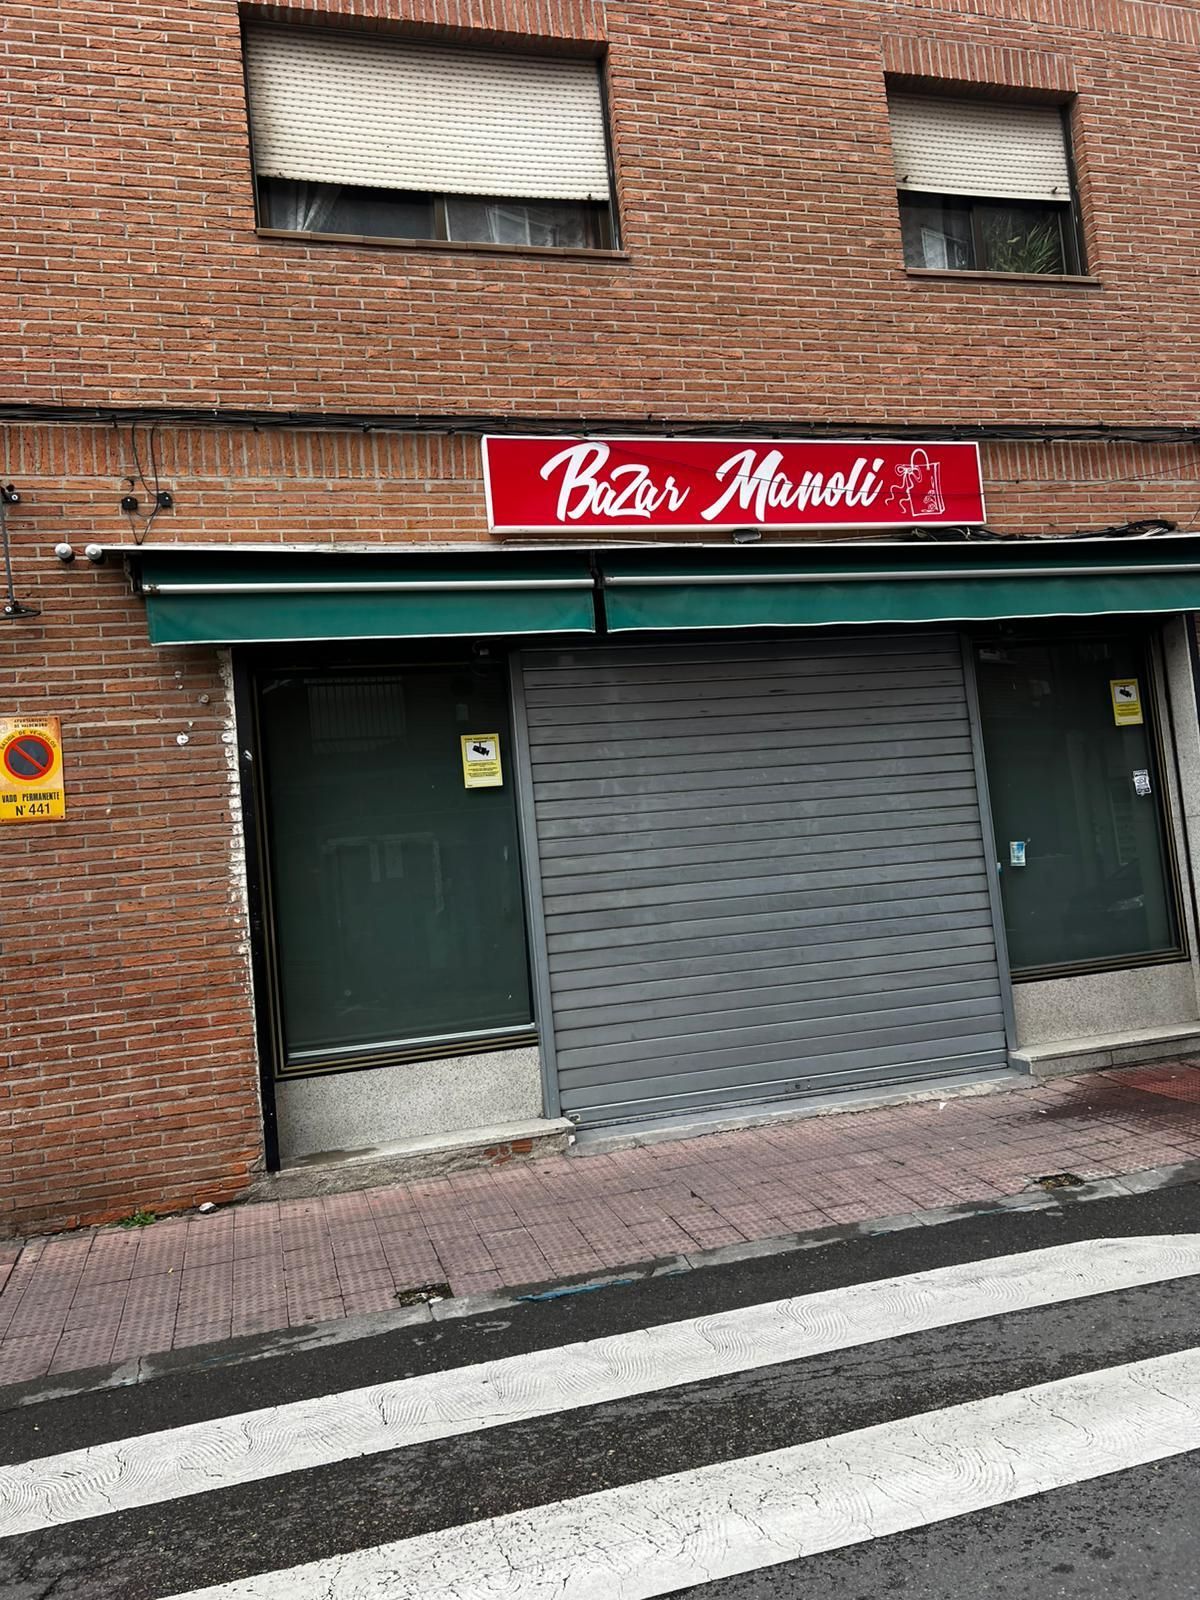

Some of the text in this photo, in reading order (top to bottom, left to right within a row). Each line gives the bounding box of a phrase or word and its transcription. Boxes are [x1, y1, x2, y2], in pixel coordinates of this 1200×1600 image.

[700, 449, 885, 522] Manoli
[2, 792, 60, 803] VADO PERMANENTE
[28, 803, 50, 815] 441
